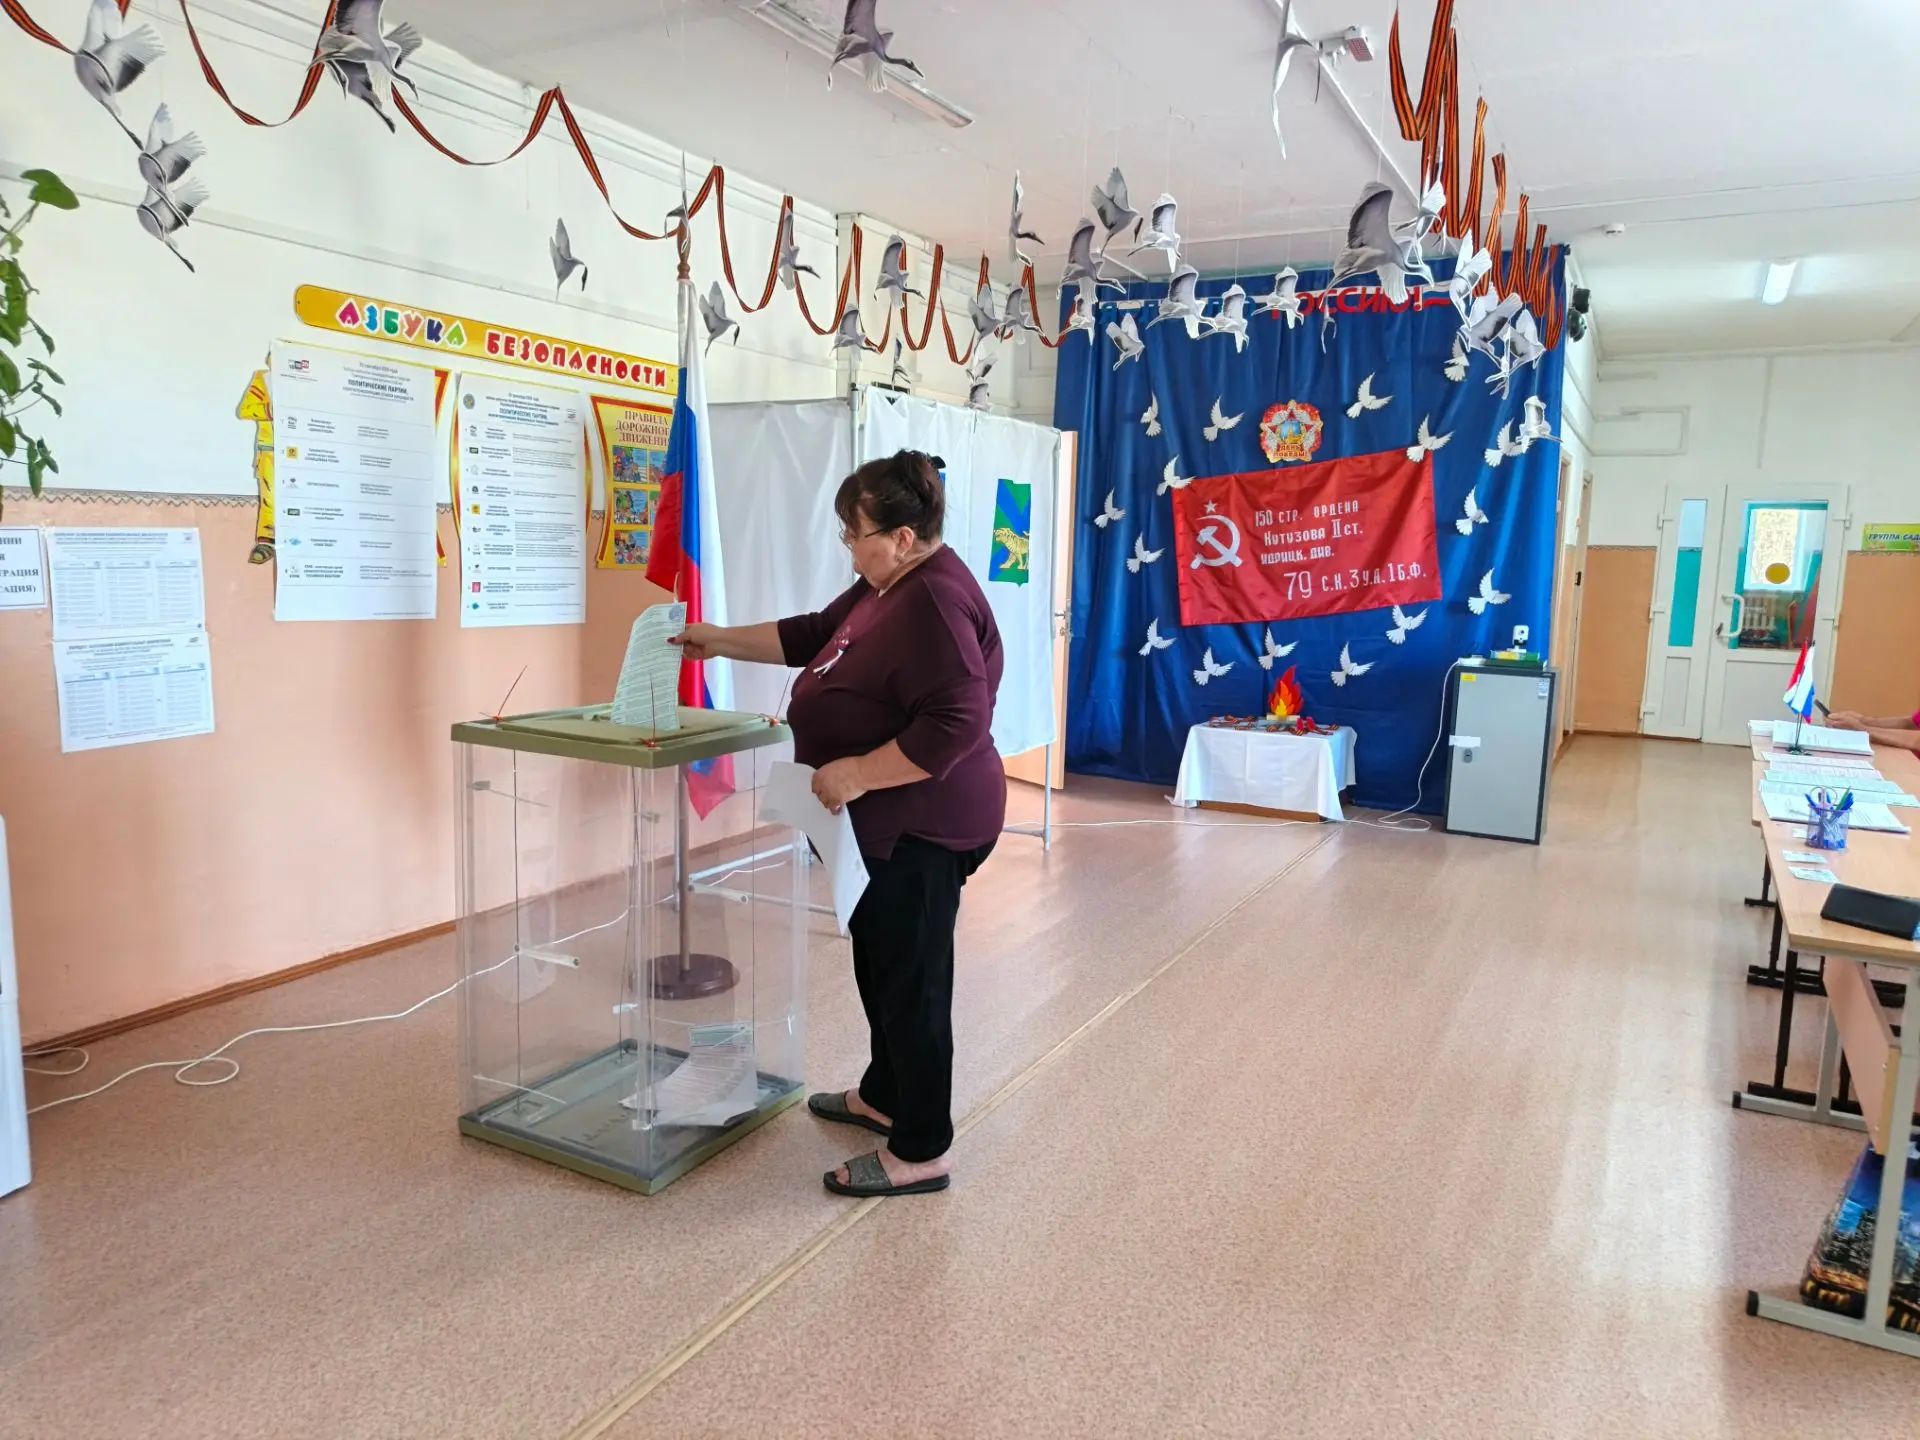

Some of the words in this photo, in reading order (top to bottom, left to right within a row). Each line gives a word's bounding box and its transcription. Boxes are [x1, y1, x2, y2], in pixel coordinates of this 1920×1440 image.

[1271, 286, 1422, 320] ОССИЮ!
[337, 300, 465, 347] АЗБУКА
[487, 332, 666, 387] БЕЗОПАСНОСТИ
[616, 420, 670, 435] ДОРОЖНОГ
[625, 410, 669, 425] ПРАВИЛА
[618, 432, 667, 447] ДВИЖЕНИ
[1255, 510, 1274, 527] 150
[1278, 511, 1303, 523] СТР.
[1313, 500, 1359, 518] ОРДЕНА
[1868, 533, 1900, 541] ГРУППА
[1261, 548, 1307, 565] ИДРИЦК.
[1310, 545, 1335, 560] ДИВ.
[1284, 571, 1312, 601] 79
